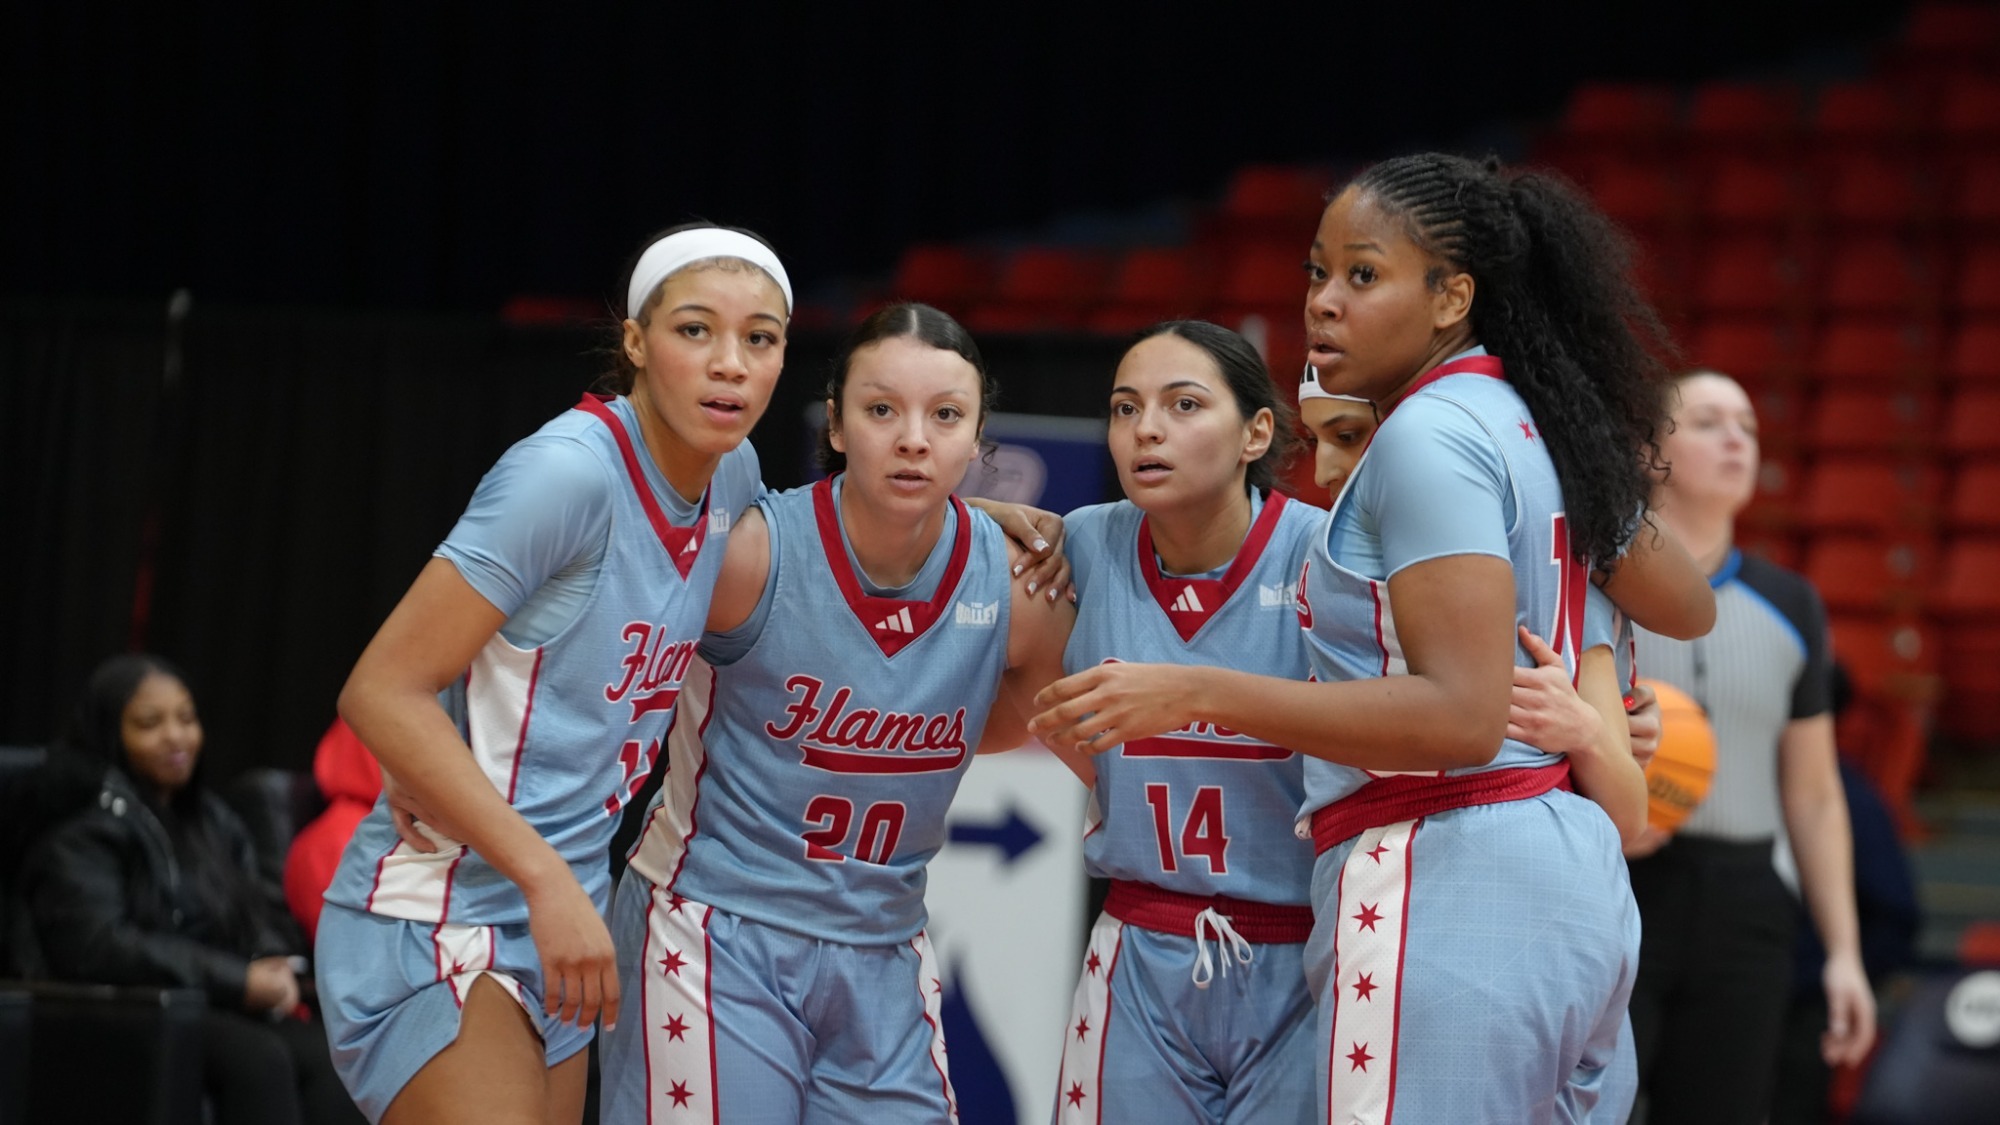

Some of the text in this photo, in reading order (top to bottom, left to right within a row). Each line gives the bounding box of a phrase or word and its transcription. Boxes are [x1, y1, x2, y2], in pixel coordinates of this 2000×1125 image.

[764, 673, 967, 753] Flames
[800, 794, 906, 866] 20
[1145, 782, 1231, 876] 14
